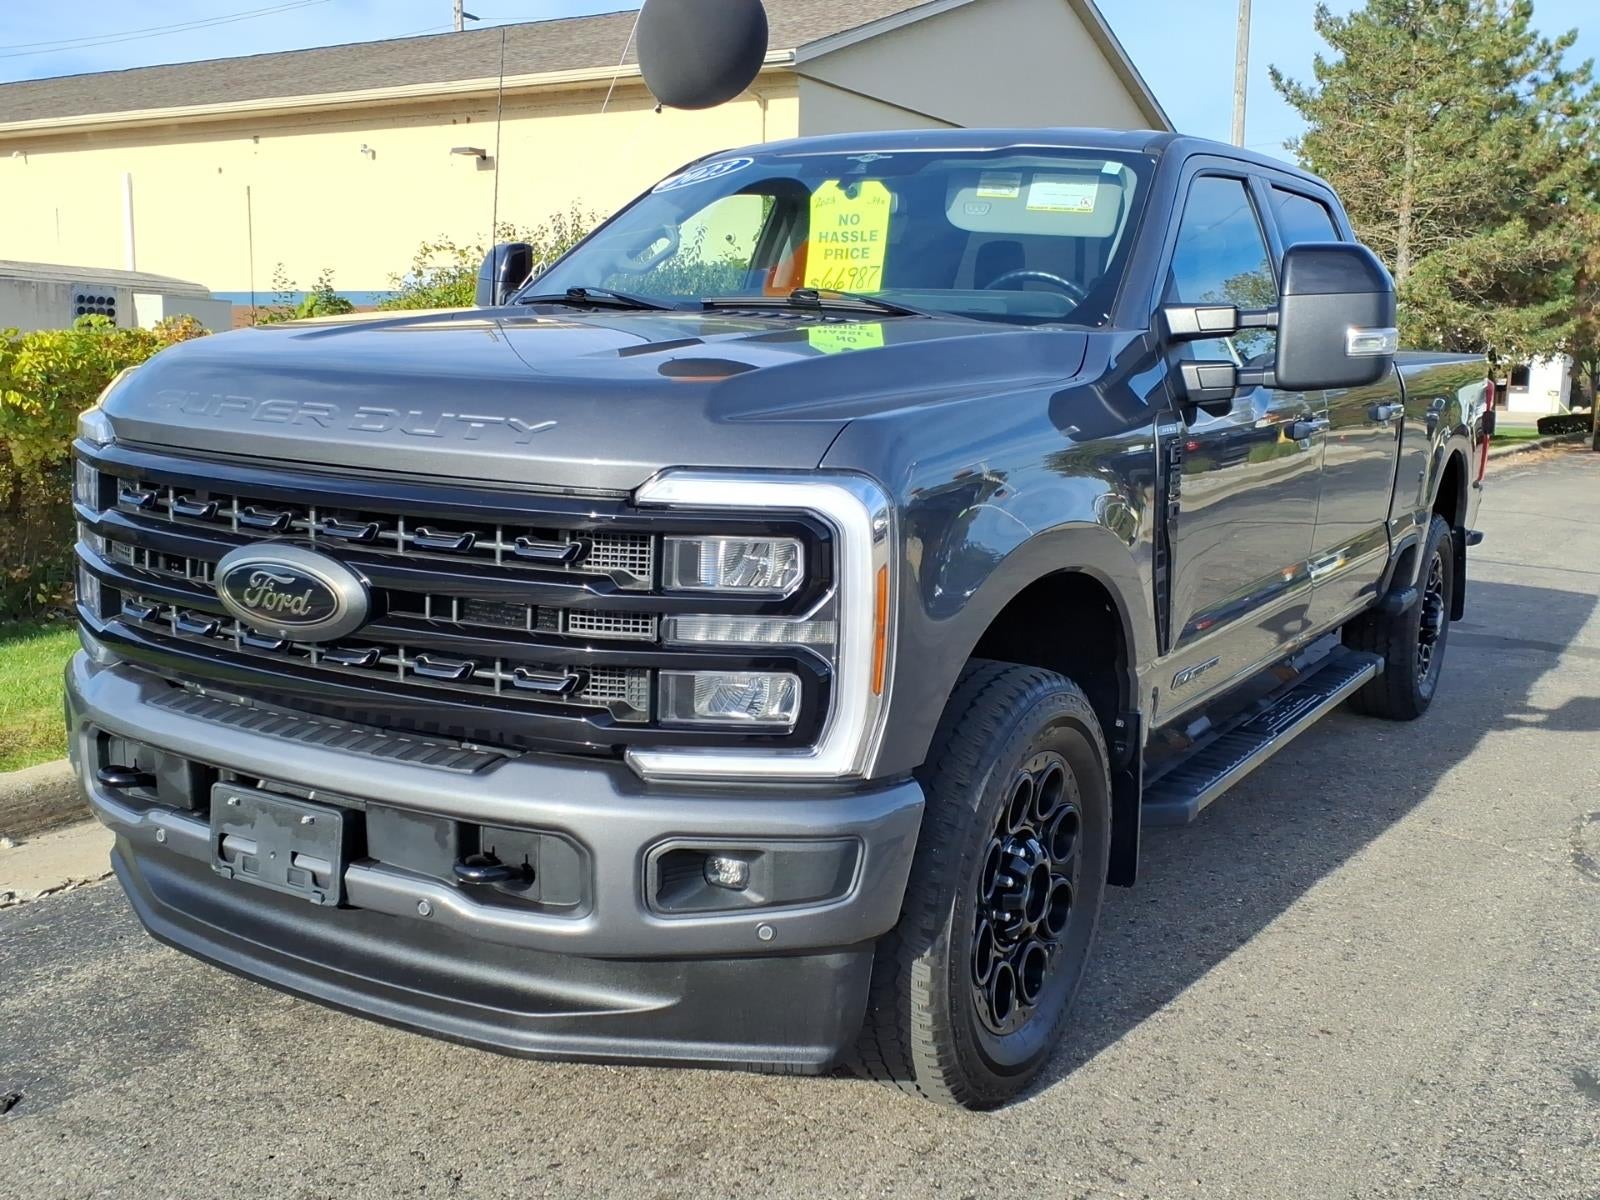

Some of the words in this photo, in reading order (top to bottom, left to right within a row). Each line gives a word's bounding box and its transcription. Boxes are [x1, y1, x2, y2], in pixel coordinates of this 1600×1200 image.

[838, 213, 861, 227] NO
[818, 229, 879, 244] HASSLE
[823, 247, 870, 260] PRICE
[810, 265, 881, 292] $66987
[148, 388, 341, 428] SUPER
[347, 405, 559, 445] DUTY
[243, 570, 313, 617] Ford
